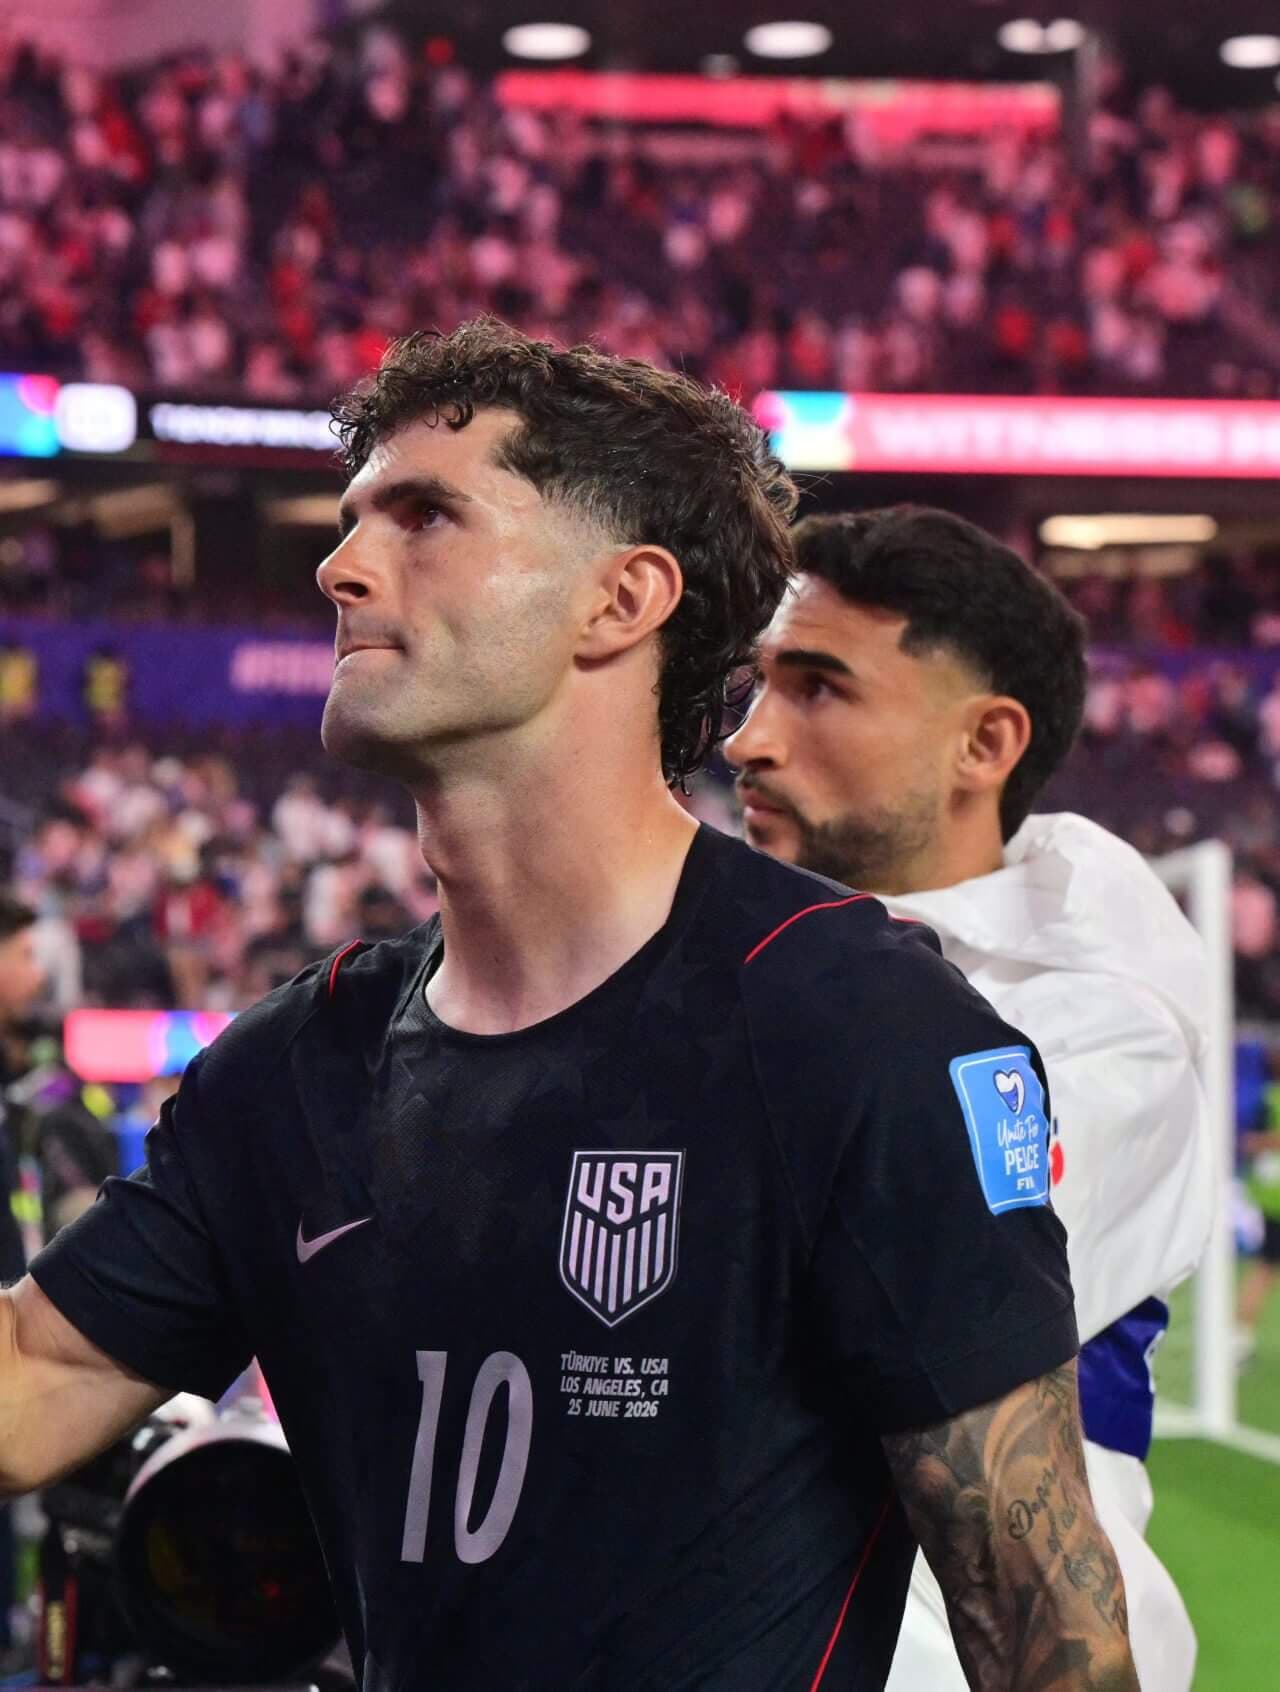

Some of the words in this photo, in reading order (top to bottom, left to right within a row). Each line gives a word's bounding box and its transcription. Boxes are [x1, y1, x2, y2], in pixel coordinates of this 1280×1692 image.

[576, 1161, 673, 1225] USA
[560, 1350, 609, 1374] TÜRKIYE
[614, 1357, 635, 1375] VS.
[640, 1358, 669, 1375] USA
[560, 1375, 581, 1393] LOS
[583, 1378, 646, 1399] ANGELES,
[650, 1379, 669, 1396] CA
[567, 1398, 582, 1415] 25
[585, 1399, 620, 1417] JUNE
[623, 1400, 660, 1418] 2026
[400, 1349, 534, 1565] 10
